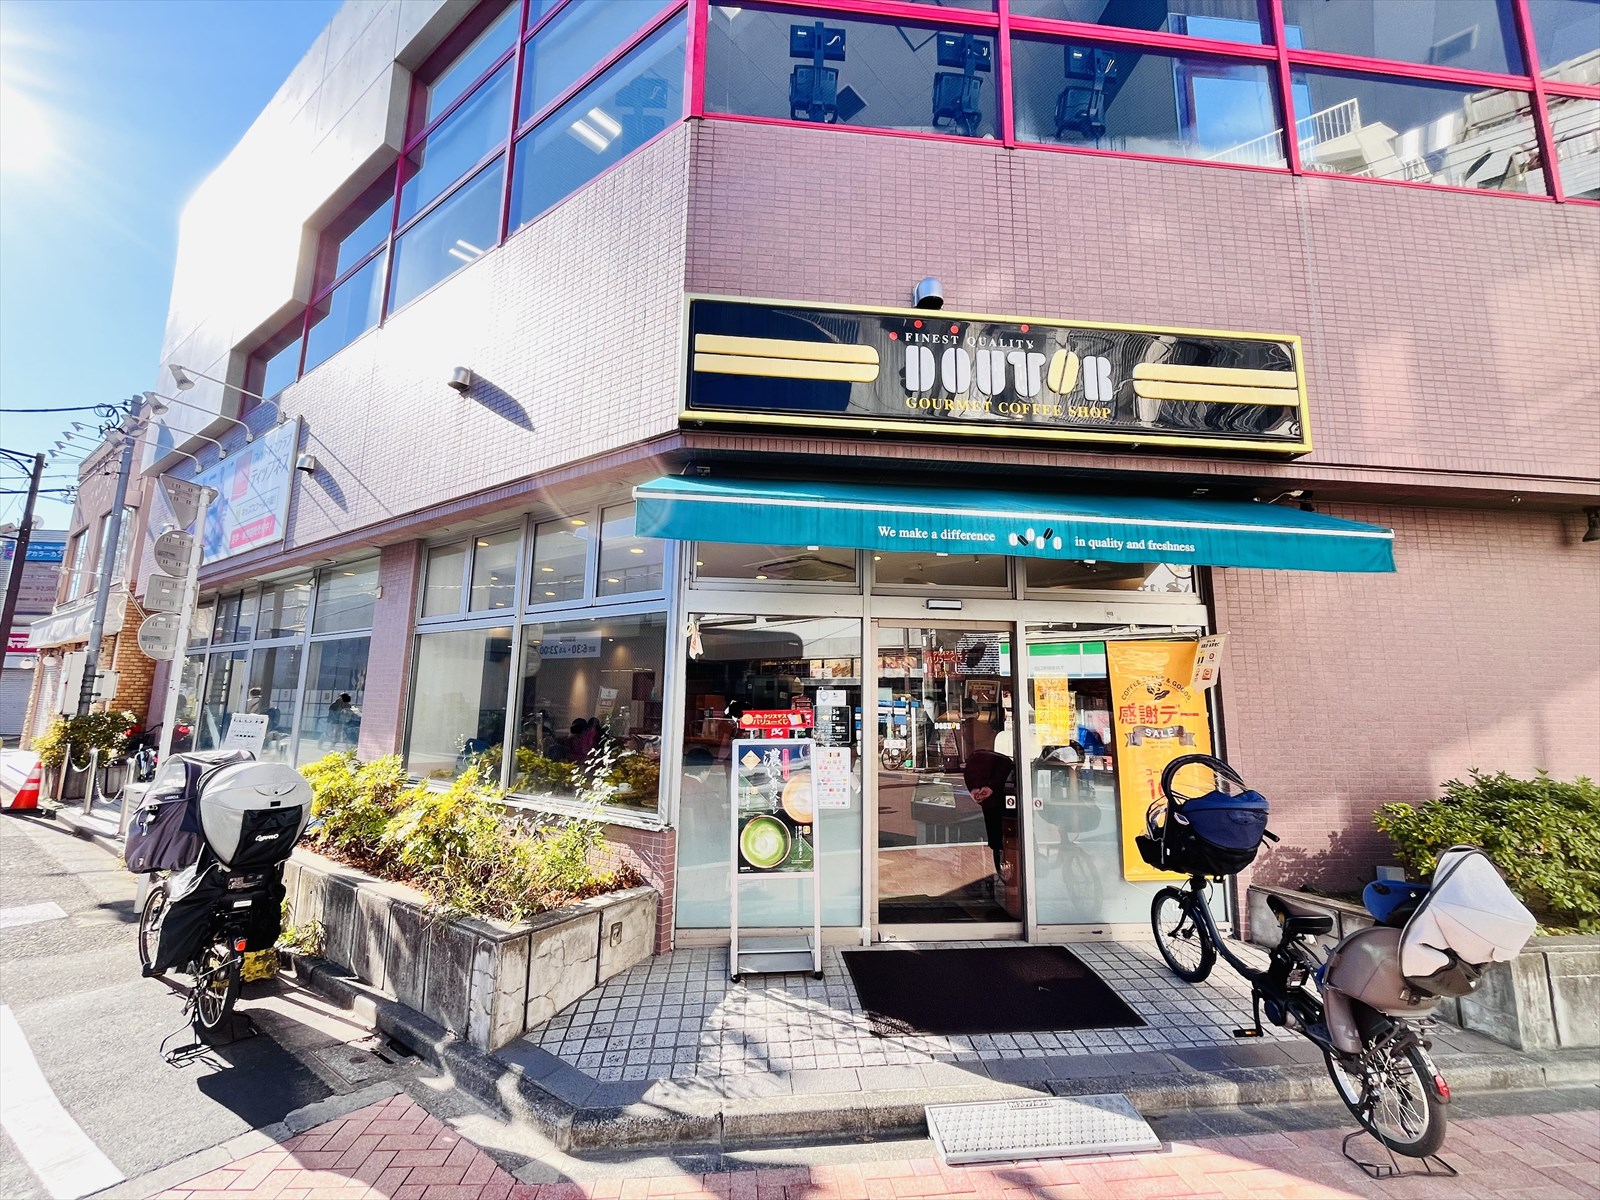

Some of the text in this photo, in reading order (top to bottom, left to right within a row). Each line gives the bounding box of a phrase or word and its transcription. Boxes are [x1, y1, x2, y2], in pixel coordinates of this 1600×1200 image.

[905, 332, 1035, 349] FINEST QUALITY
[905, 345, 1113, 401] DOUTOR
[905, 397, 1112, 419] GOURMET COFFEE SHOP
[878, 525, 1196, 552] We make a difference in quality and freshness
[1121, 679, 1142, 701] COFFEE
[1172, 680, 1192, 701] GOODS
[1118, 702, 1200, 725] 感謝デー
[1145, 727, 1175, 738] SALE
